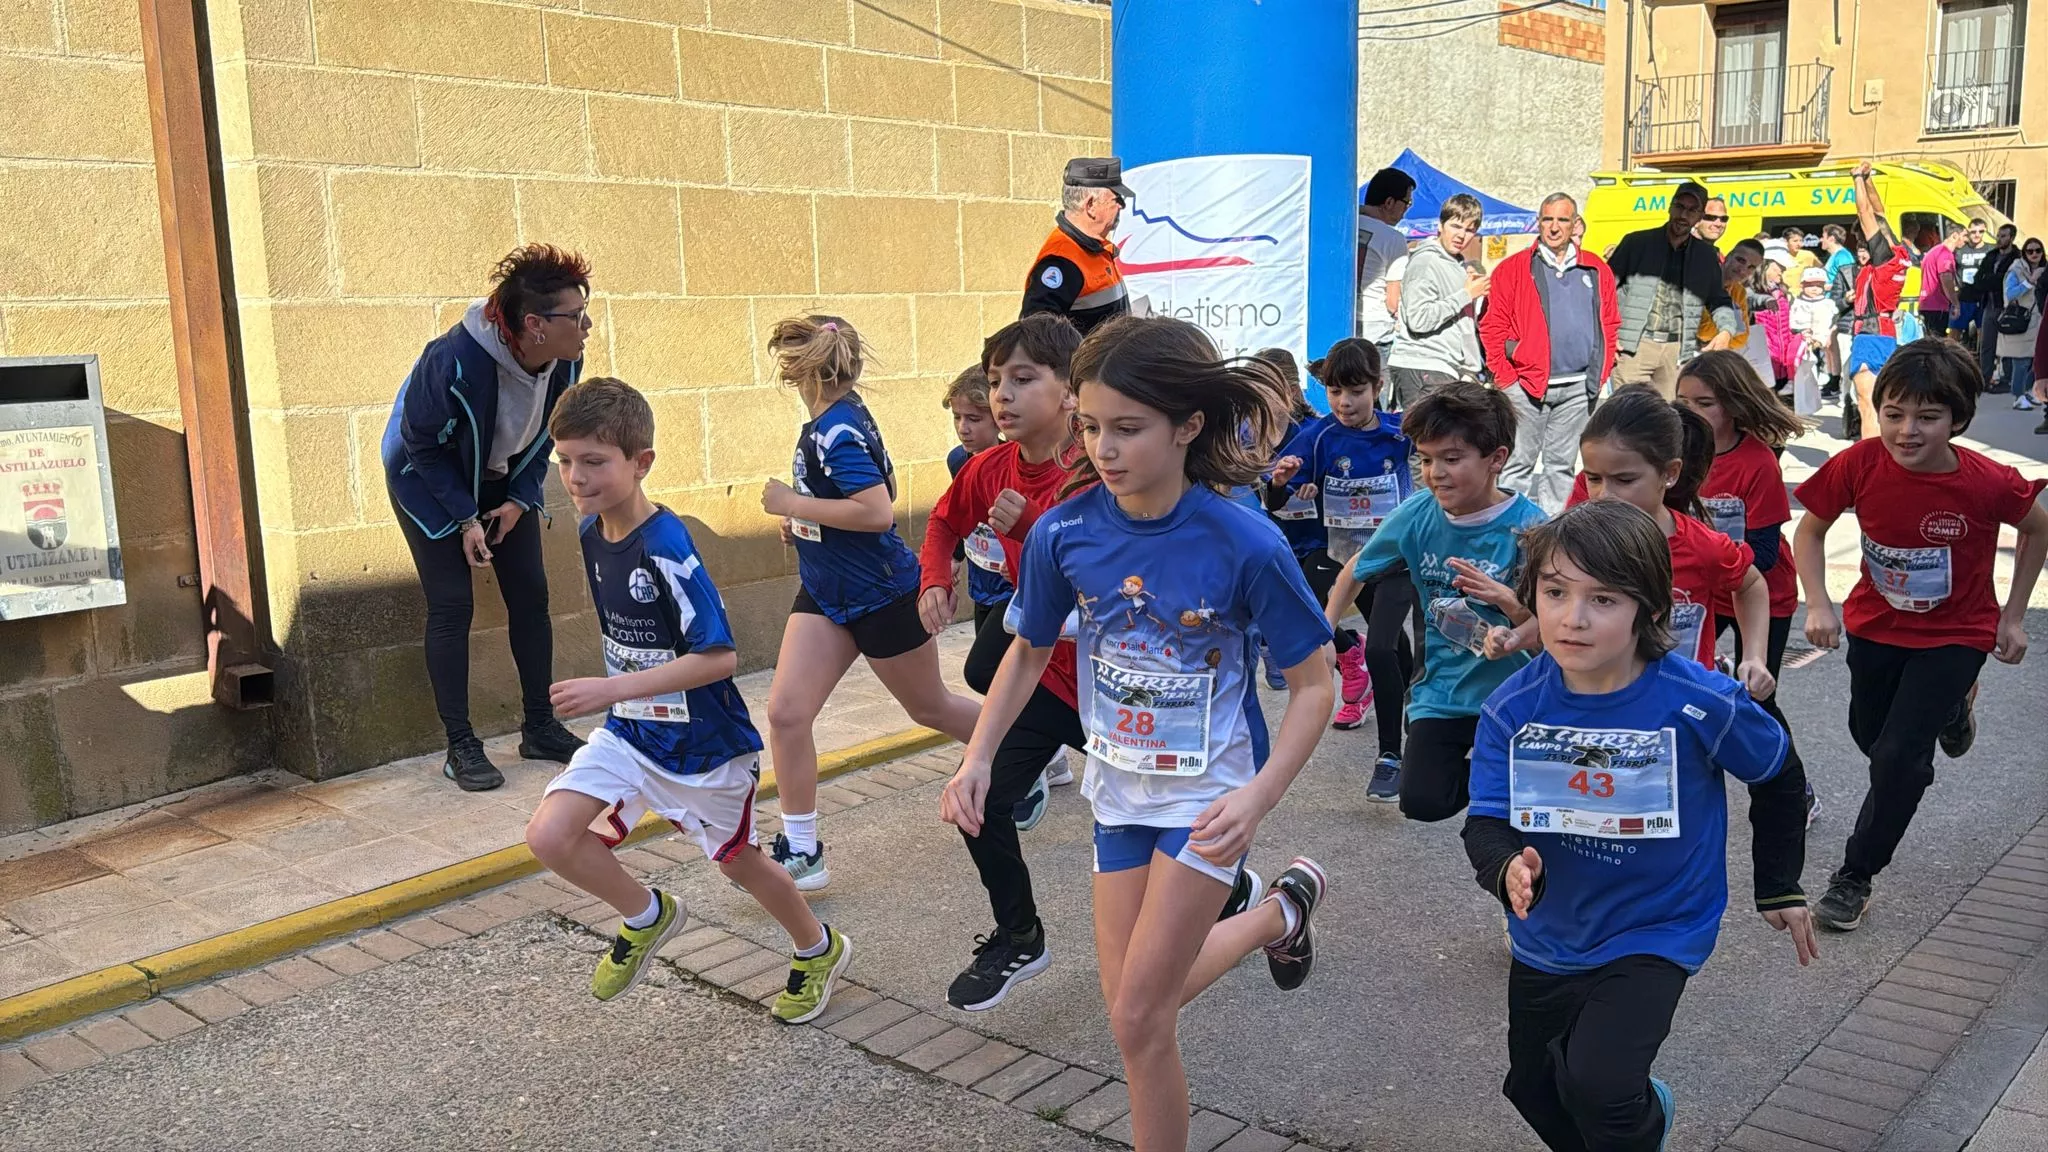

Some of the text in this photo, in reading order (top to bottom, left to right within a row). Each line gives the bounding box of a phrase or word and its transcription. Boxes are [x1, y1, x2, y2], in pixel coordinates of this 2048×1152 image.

[1633, 190, 1785, 212] AMNCIA
[15, 431, 82, 447] AYUNTAMIENTO
[28, 448, 45, 458] DE
[0, 457, 86, 473] ASTILLAZUELO
[1349, 498, 1370, 511] 30
[975, 537, 988, 551] 10
[1884, 570, 1908, 587] 37
[1111, 670, 1201, 692] CARRERA
[1116, 708, 1154, 736] 28
[1108, 731, 1167, 748] VALENTINA
[1518, 741, 1562, 751] CAMPO
[1554, 730, 1660, 748] CARRERA
[1180, 756, 1203, 768] PEDAL
[1611, 757, 1659, 768] FEBRERO
[1568, 770, 1615, 798] 43
[1646, 817, 1673, 829] PEDAL
